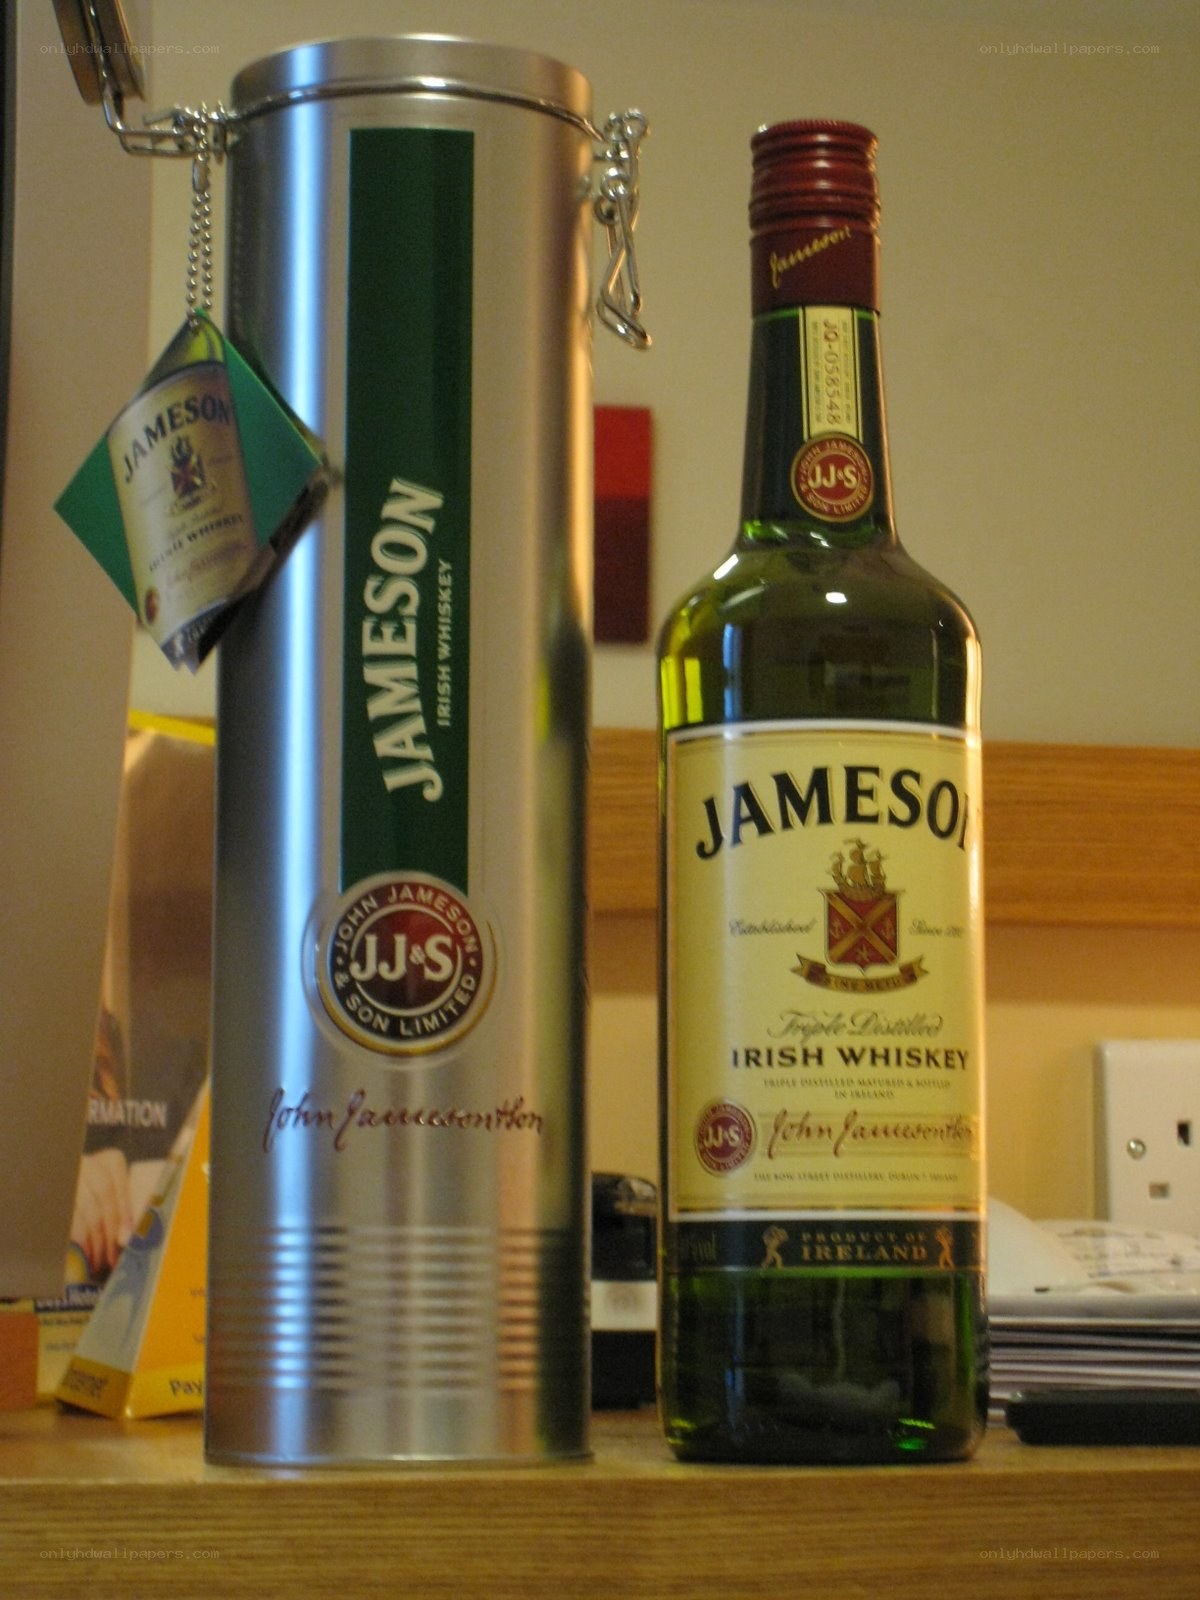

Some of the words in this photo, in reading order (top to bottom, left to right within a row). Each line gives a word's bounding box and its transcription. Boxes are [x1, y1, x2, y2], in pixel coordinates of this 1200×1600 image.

[123, 393, 230, 484] JAMESON
[362, 477, 445, 802] JAMESON
[437, 557, 453, 661] WHISKEY
[437, 663, 452, 728] IRISH
[335, 894, 380, 955] JOHN
[387, 884, 479, 954] JAMESON
[350, 932, 454, 982] JJ&S
[346, 993, 391, 1033] SON
[400, 974, 477, 1036] LIMITED
[731, 1046, 825, 1069] IRISH
[836, 1046, 969, 1071] WHISKEY
[801, 1244, 929, 1262] IRELAND
